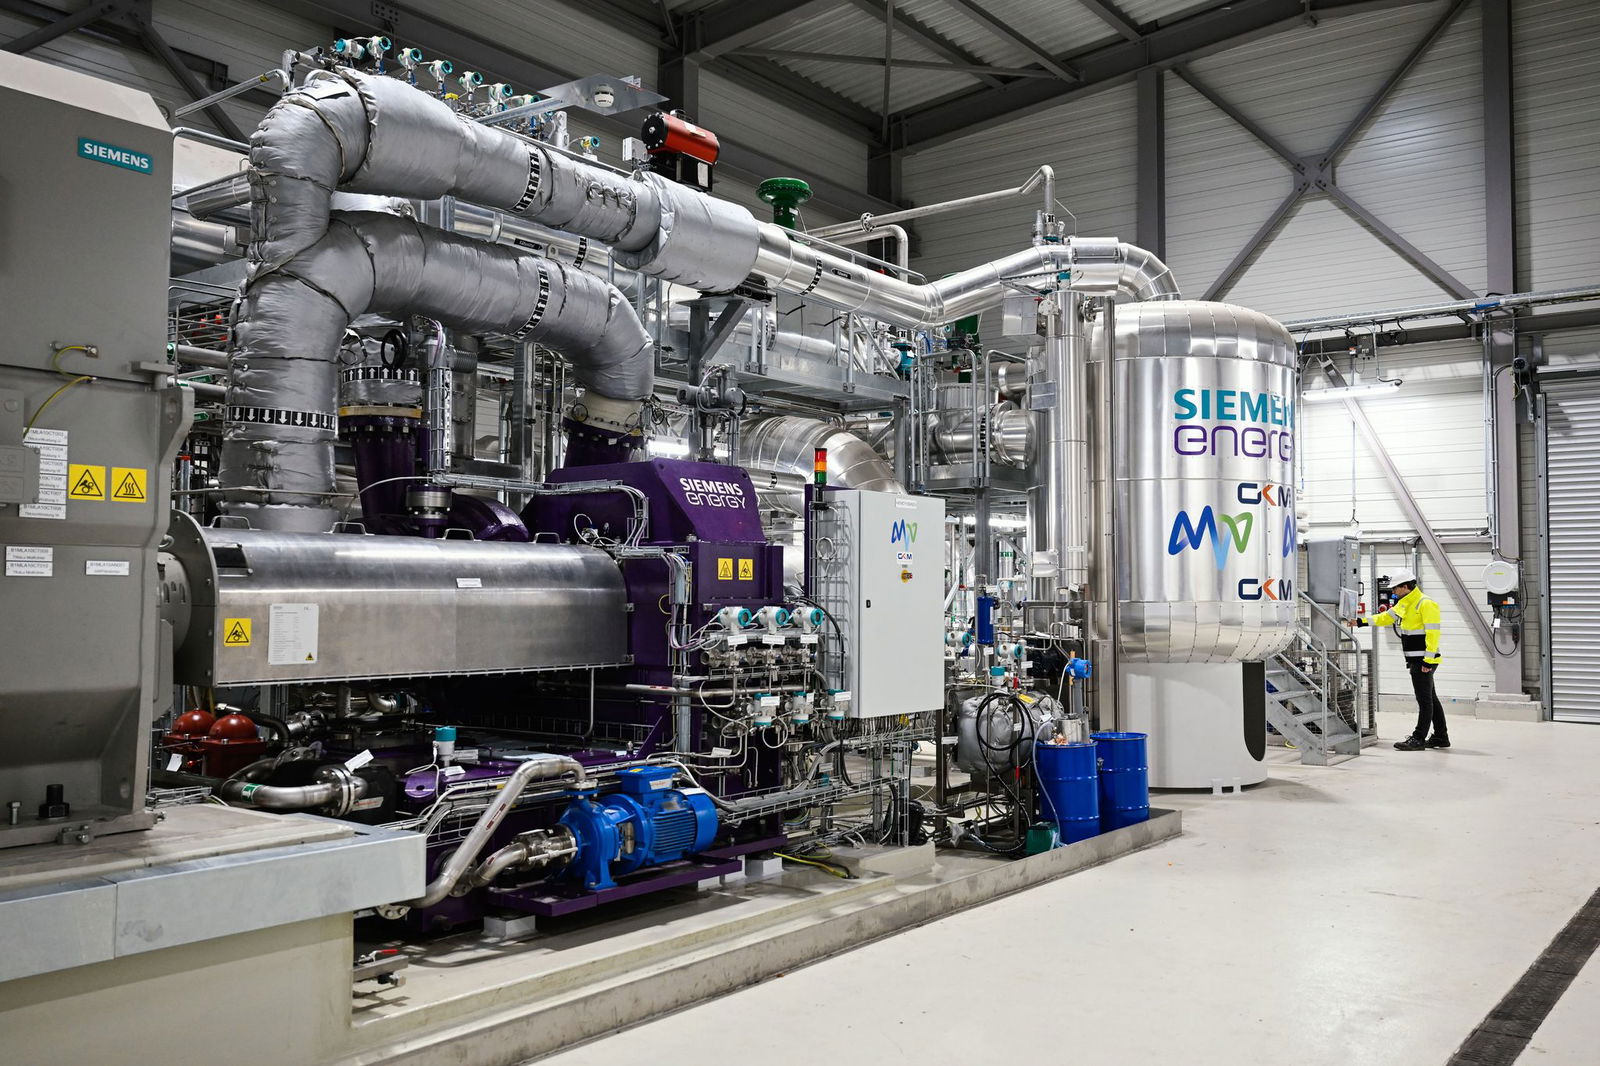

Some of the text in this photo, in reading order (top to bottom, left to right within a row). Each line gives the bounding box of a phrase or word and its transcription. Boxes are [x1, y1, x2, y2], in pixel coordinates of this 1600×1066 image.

[84, 142, 149, 169] SIEMENS
[1173, 388, 1295, 429] SIEMEN
[1173, 425, 1295, 462] energ
[679, 477, 743, 496] SIEMENS
